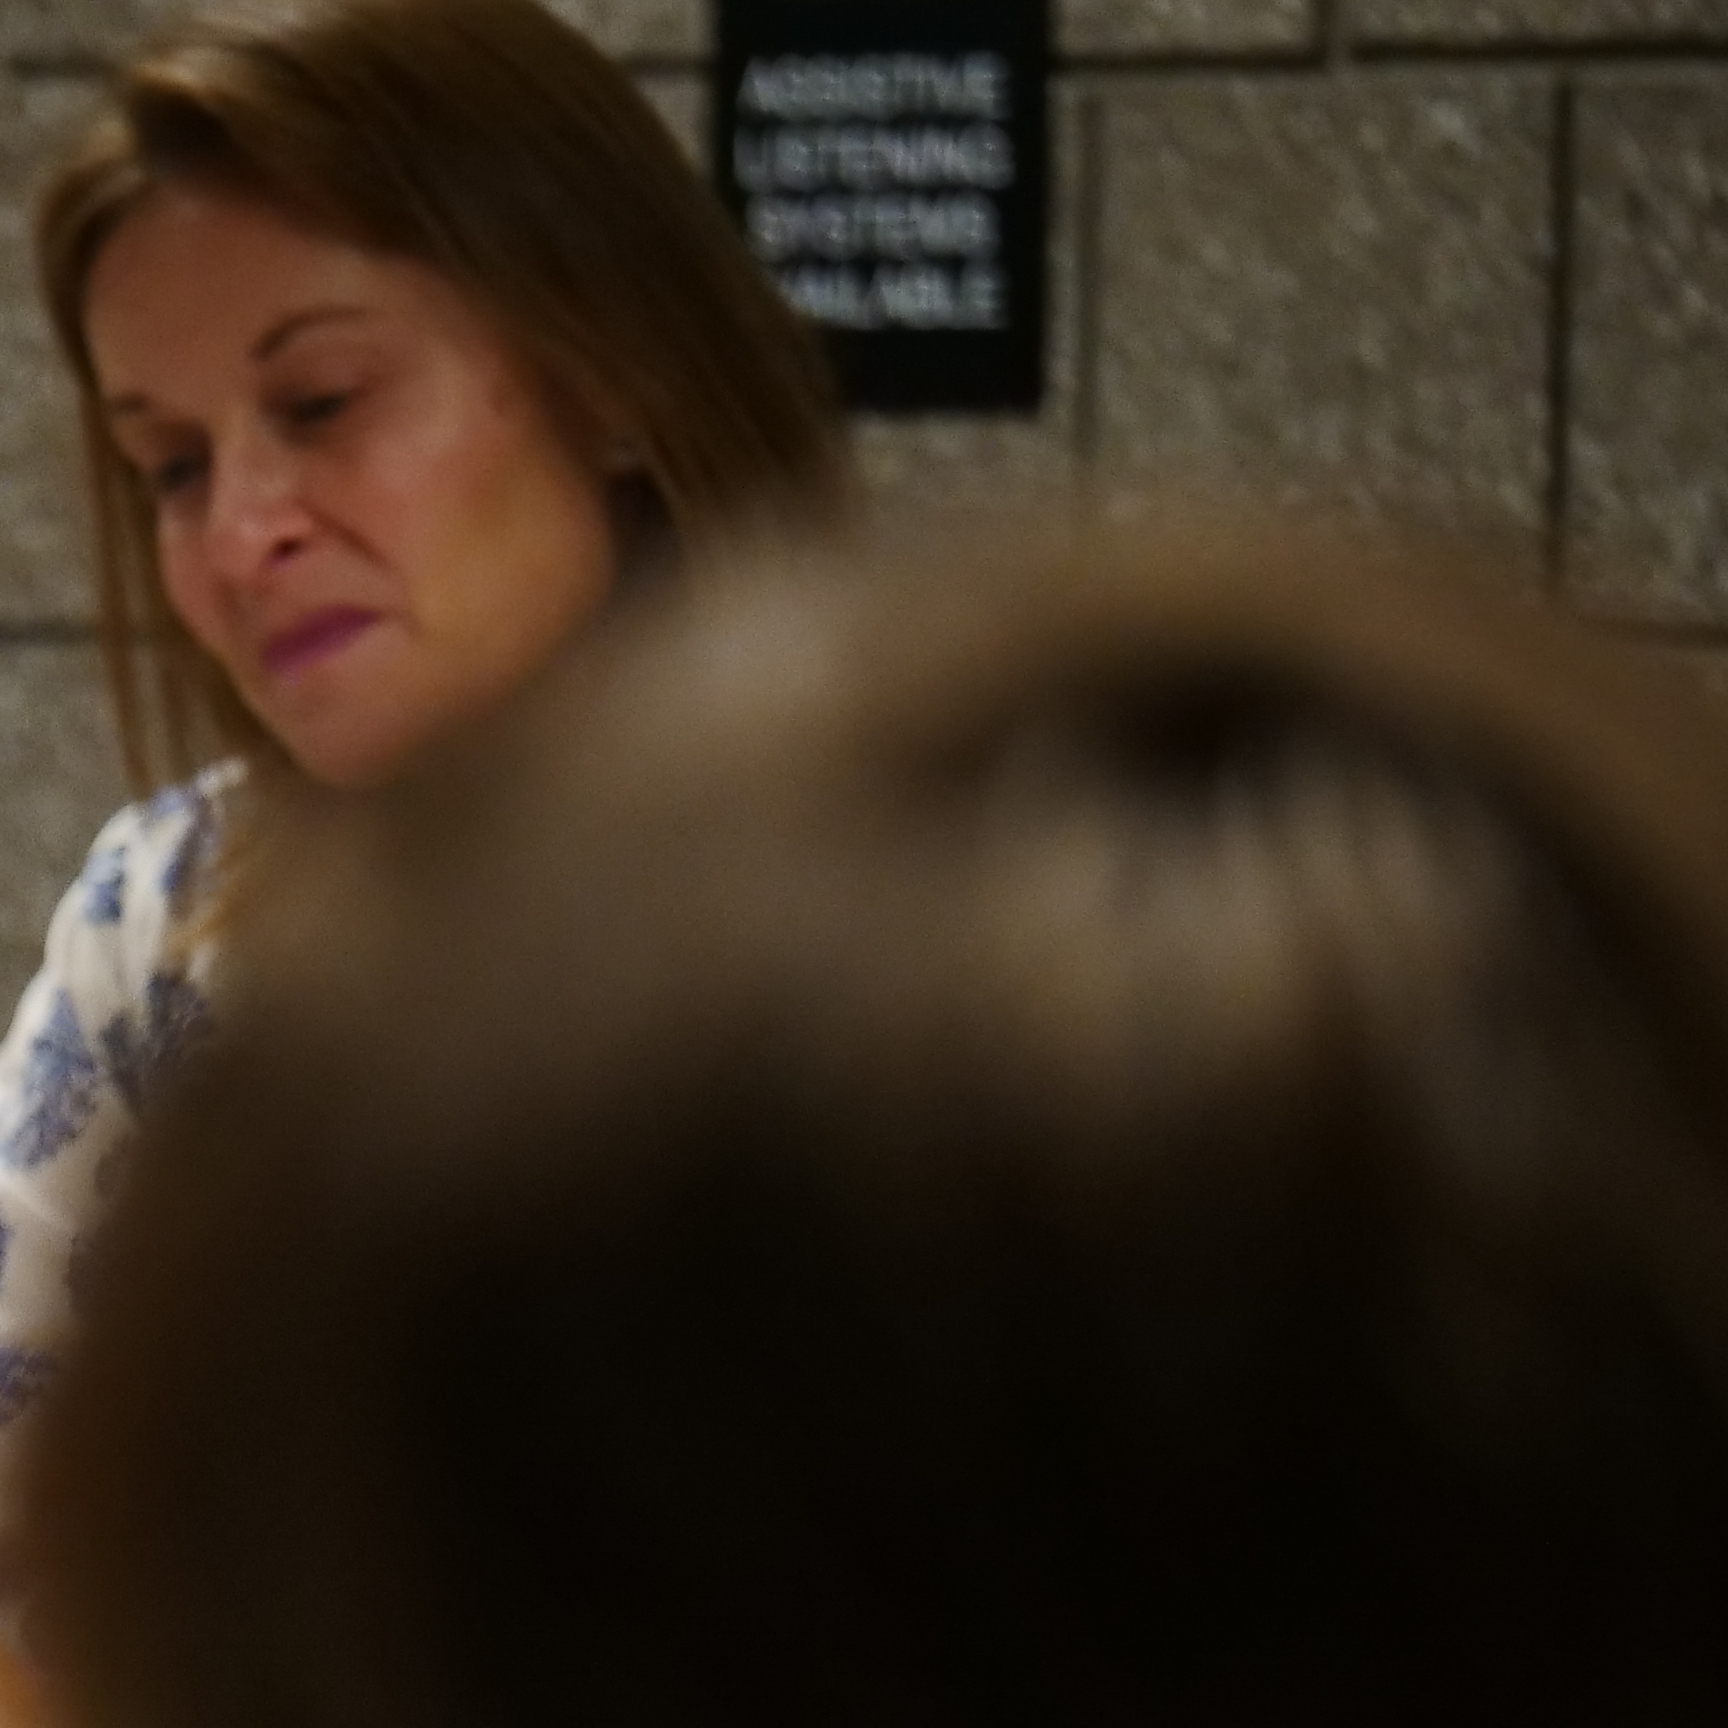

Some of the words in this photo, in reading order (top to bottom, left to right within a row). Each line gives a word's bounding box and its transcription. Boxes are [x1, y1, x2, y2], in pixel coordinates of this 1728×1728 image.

[738, 53, 1009, 118] ASSISTIVE
[734, 124, 1014, 188] LISTENING
[747, 196, 999, 261] SYSTEMS
